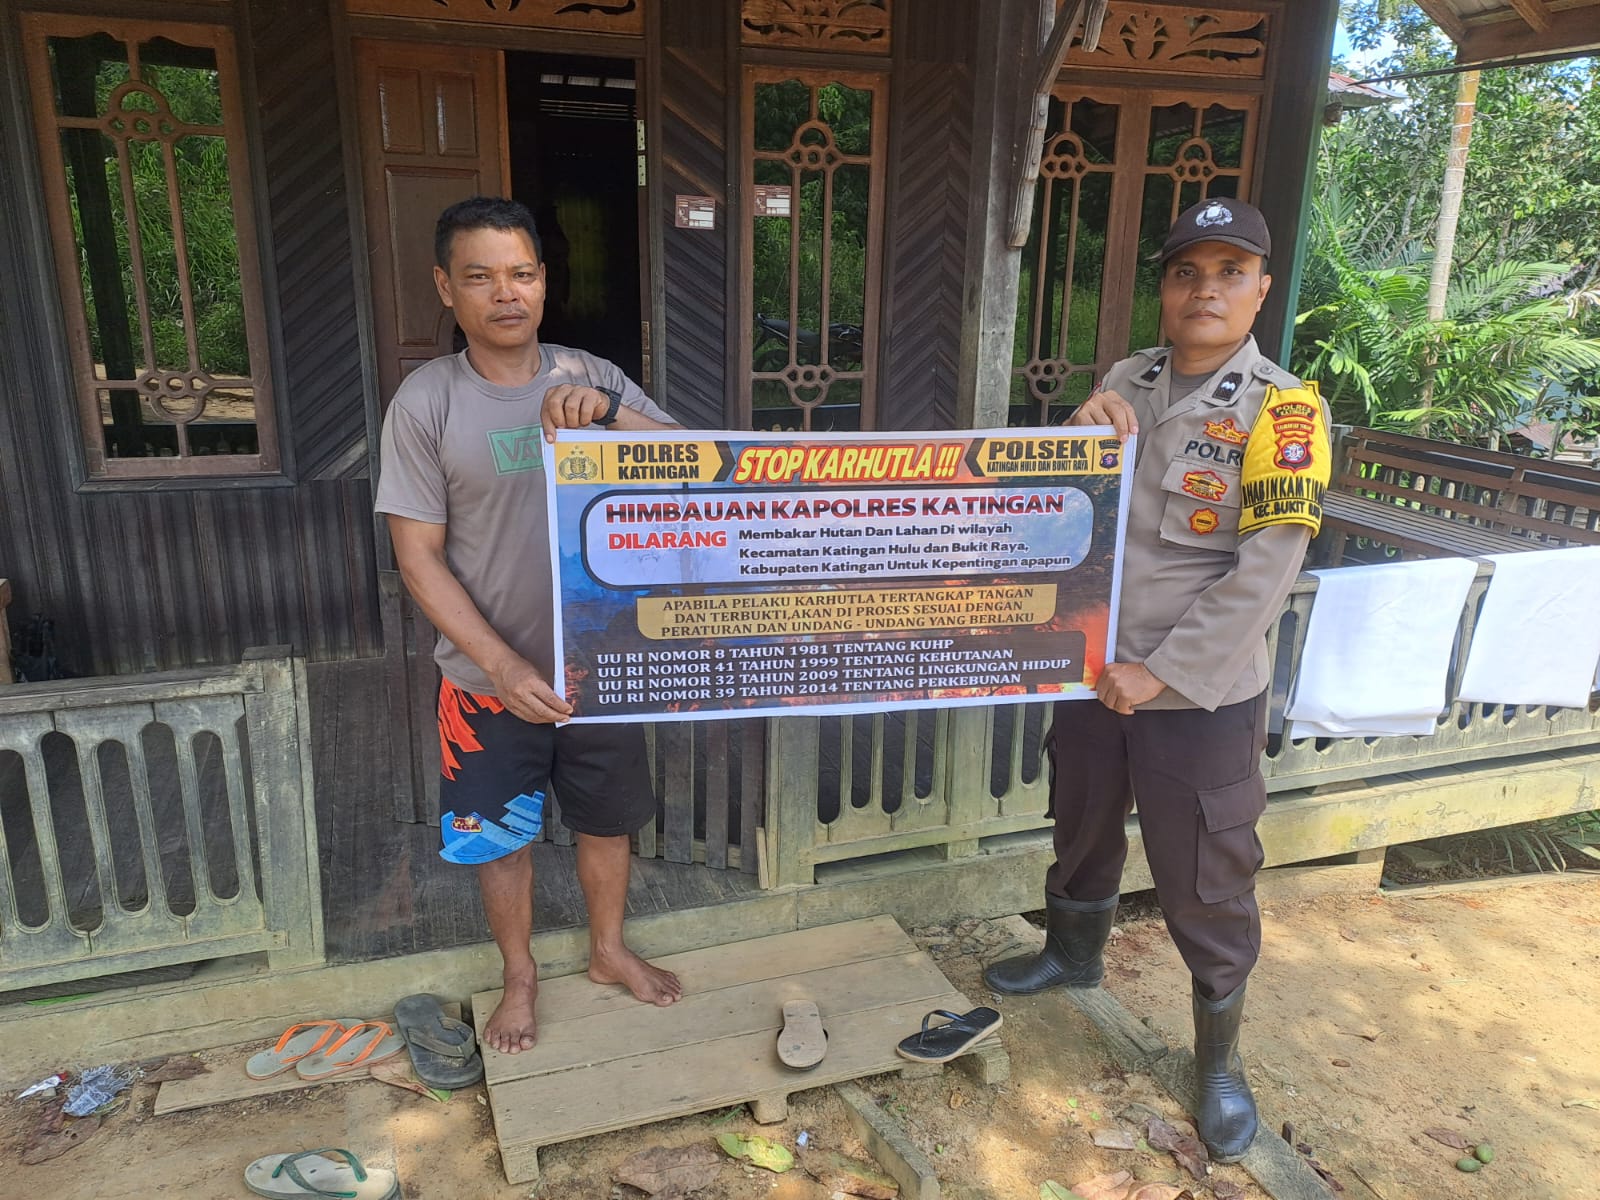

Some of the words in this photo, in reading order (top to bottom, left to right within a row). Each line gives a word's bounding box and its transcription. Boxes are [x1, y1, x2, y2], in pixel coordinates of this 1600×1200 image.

[618, 444, 699, 463] POLRES
[989, 440, 1088, 460] POLSEK
[618, 465, 699, 480] KATINGAN
[734, 447, 805, 482] STOP
[987, 461, 1018, 472] KATINGAN
[1021, 461, 1036, 471] HULU
[1038, 461, 1051, 471] DAN
[1053, 460, 1071, 471] BUKIT
[1073, 460, 1088, 470] RAYA
[605, 501, 766, 524] HIMBAUAN
[772, 498, 916, 520] KAPOLRES
[922, 494, 1064, 516] KATINGAN
[608, 531, 727, 550] DILARANG
[739, 528, 816, 539] Membakar
[820, 528, 862, 538] Hutan
[865, 527, 892, 536] Dan
[896, 525, 938, 536] Lahan
[941, 525, 955, 534] Di
[959, 523, 1012, 536] wilayah
[740, 547, 819, 558] Kecamatan
[822, 545, 885, 557] Katingan
[888, 544, 920, 554] Hulu
[924, 543, 948, 553] dan
[952, 542, 988, 552] Bukit
[991, 542, 1029, 552] Raya,
[740, 564, 818, 576] Kabupaten
[822, 562, 884, 573] Katingan
[888, 559, 928, 570] Untuk
[932, 558, 1018, 570] Kepentingan
[1021, 557, 1070, 568] apapun
[663, 599, 728, 610] APABILA
[732, 597, 790, 608] PELAKU
[795, 591, 876, 606] KARHUTLA
[879, 591, 973, 603] TERTANGKAP
[977, 589, 1034, 599] TANGAN
[675, 613, 706, 623] DAN
[836, 607, 852, 617] DI
[856, 605, 909, 616] PROSES
[913, 603, 962, 614] SESUAI
[965, 601, 1022, 612] DENGAN
[661, 624, 752, 637] PERATURAN
[757, 622, 787, 633] DAN
[792, 620, 852, 631] UNDANG
[865, 616, 925, 628] UNDANG
[930, 615, 965, 625] YANG
[970, 613, 1034, 624] BERLAKU
[597, 654, 621, 664] UU
[626, 653, 643, 662] RI
[648, 651, 710, 662] NOMOR
[715, 649, 725, 659] 8
[730, 647, 784, 658] TAHUN
[790, 645, 827, 655] 1981
[833, 642, 906, 653] TENTANG
[910, 640, 954, 650] KUHP
[597, 667, 622, 678] UU
[626, 666, 643, 676] RI
[649, 664, 711, 675] NOMOR
[715, 662, 733, 672] 41
[739, 659, 795, 670] TAHUN
[801, 658, 838, 667] 1999
[843, 655, 915, 666] TENTANG
[920, 650, 1013, 662] KEHUTANAN
[598, 681, 622, 691] UU
[627, 679, 644, 689] RI
[649, 677, 711, 688] NOMOR
[715, 675, 735, 685] 32
[739, 672, 794, 683] TAHUN
[799, 670, 838, 680] 2009
[843, 668, 914, 678] TENTANG
[919, 662, 1018, 675] LINGKUNGAN
[1022, 659, 1071, 670] HIDUP
[598, 694, 622, 704] UU
[627, 693, 644, 702] RI
[649, 690, 711, 702] NOMOR
[715, 688, 735, 697] 39
[739, 685, 794, 697] TAHUN
[799, 683, 838, 693] 2014
[843, 680, 914, 691] TENTANG
[918, 674, 1021, 687] PERKEBUNAN
